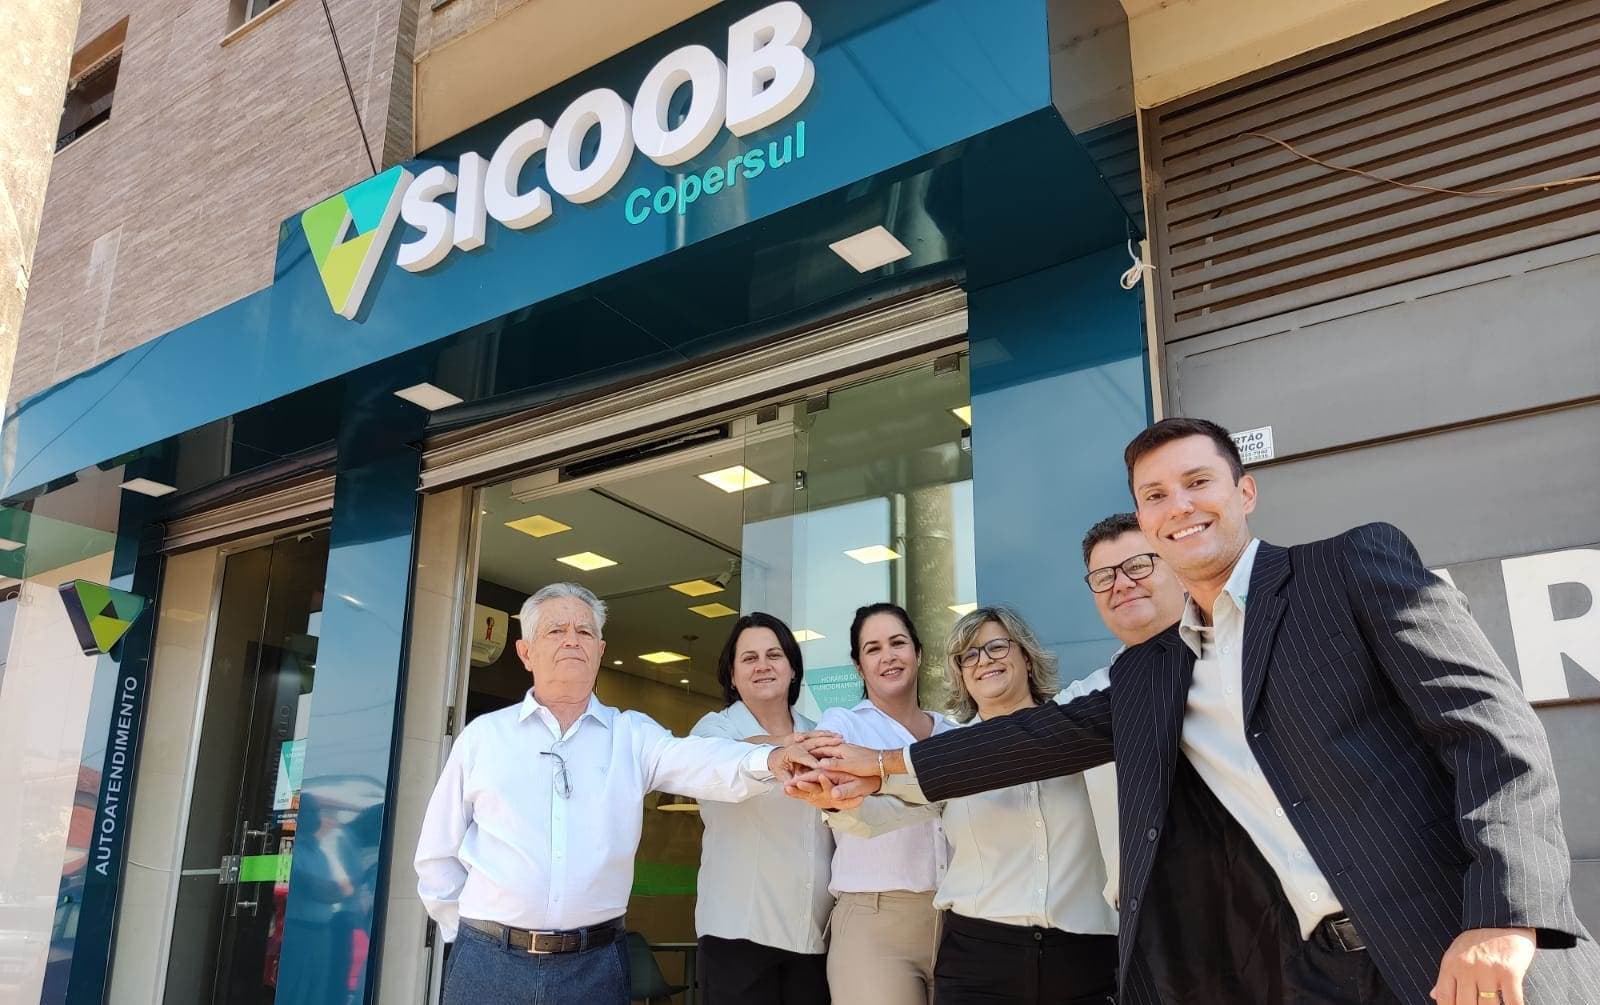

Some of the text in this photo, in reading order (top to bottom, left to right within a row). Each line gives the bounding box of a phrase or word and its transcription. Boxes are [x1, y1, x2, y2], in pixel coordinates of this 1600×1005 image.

[396, 1, 815, 273] SICOOB
[624, 120, 806, 225] Copersul
[1233, 433, 1263, 444] RTÃO
[1239, 442, 1264, 452] NICO
[95, 676, 138, 876] AUTOATENDIMENTO
